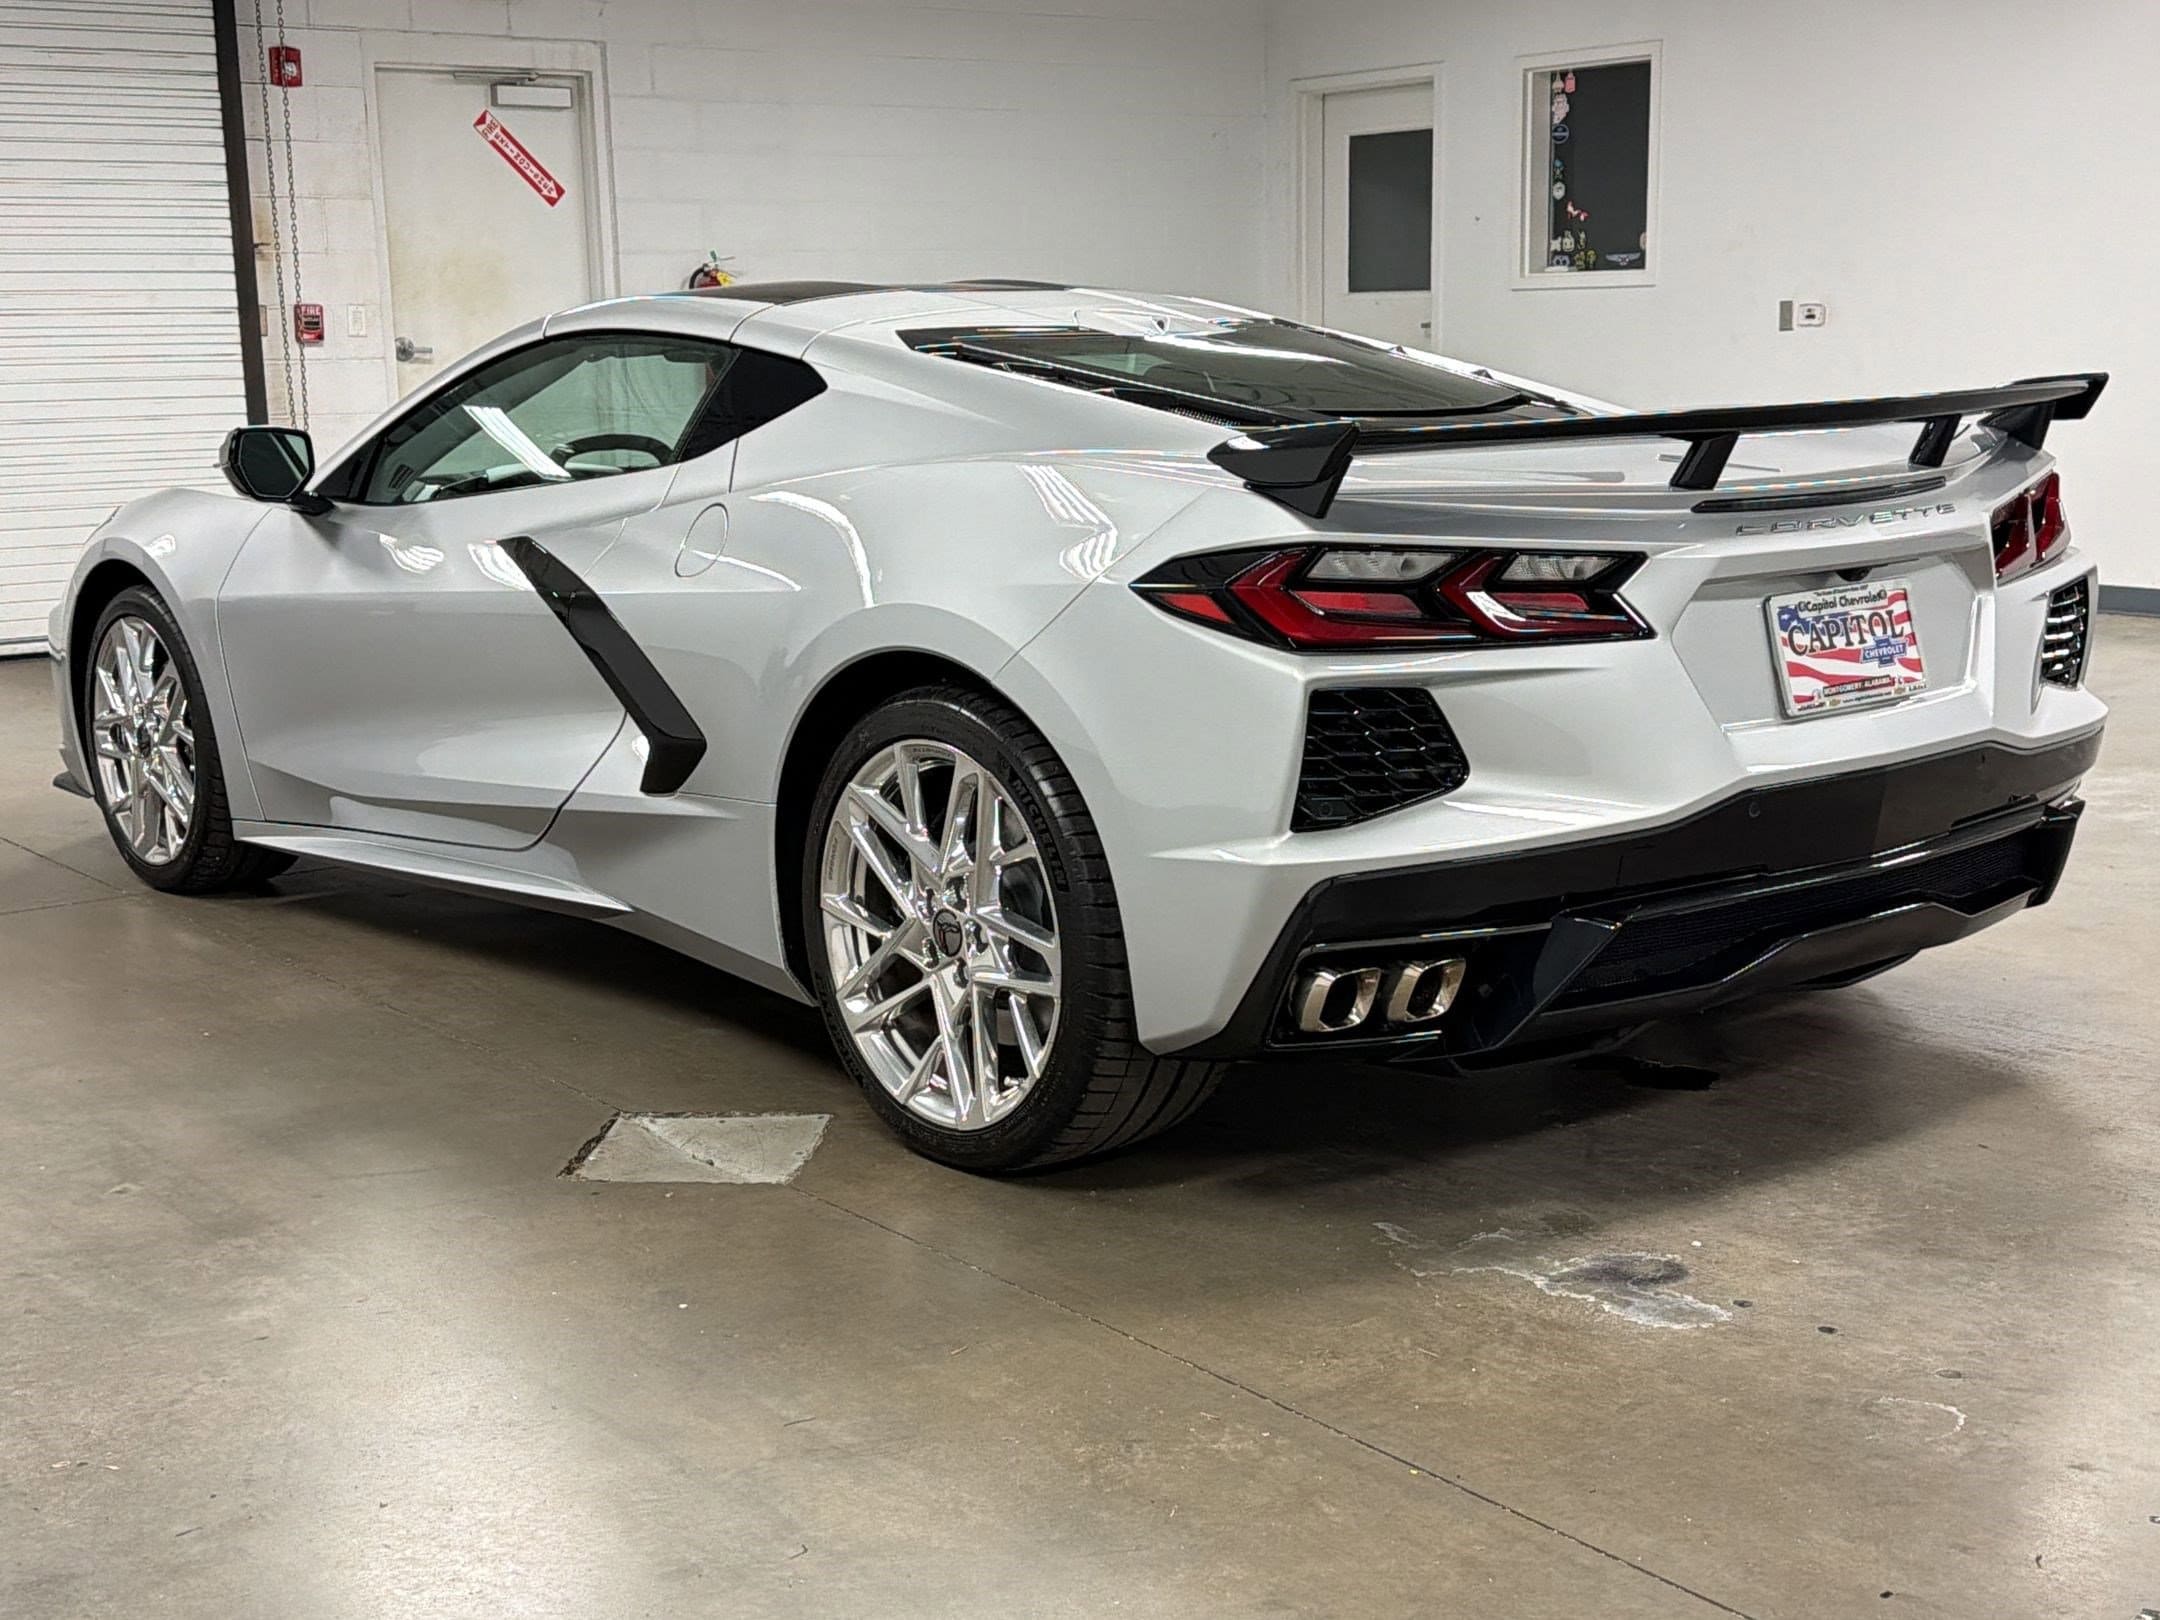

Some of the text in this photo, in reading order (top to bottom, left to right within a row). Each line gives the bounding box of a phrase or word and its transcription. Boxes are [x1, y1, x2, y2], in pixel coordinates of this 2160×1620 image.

[481, 119, 499, 139] FIRE
[494, 133, 555, 195] EXTINGUISHER
[301, 306, 320, 314] FIRE
[1735, 503, 1956, 536] CORVETTE
[1805, 597, 1838, 613] Capitol
[1787, 609, 1905, 656] CAPITOL
[1864, 644, 1905, 658] CHEVROLET
